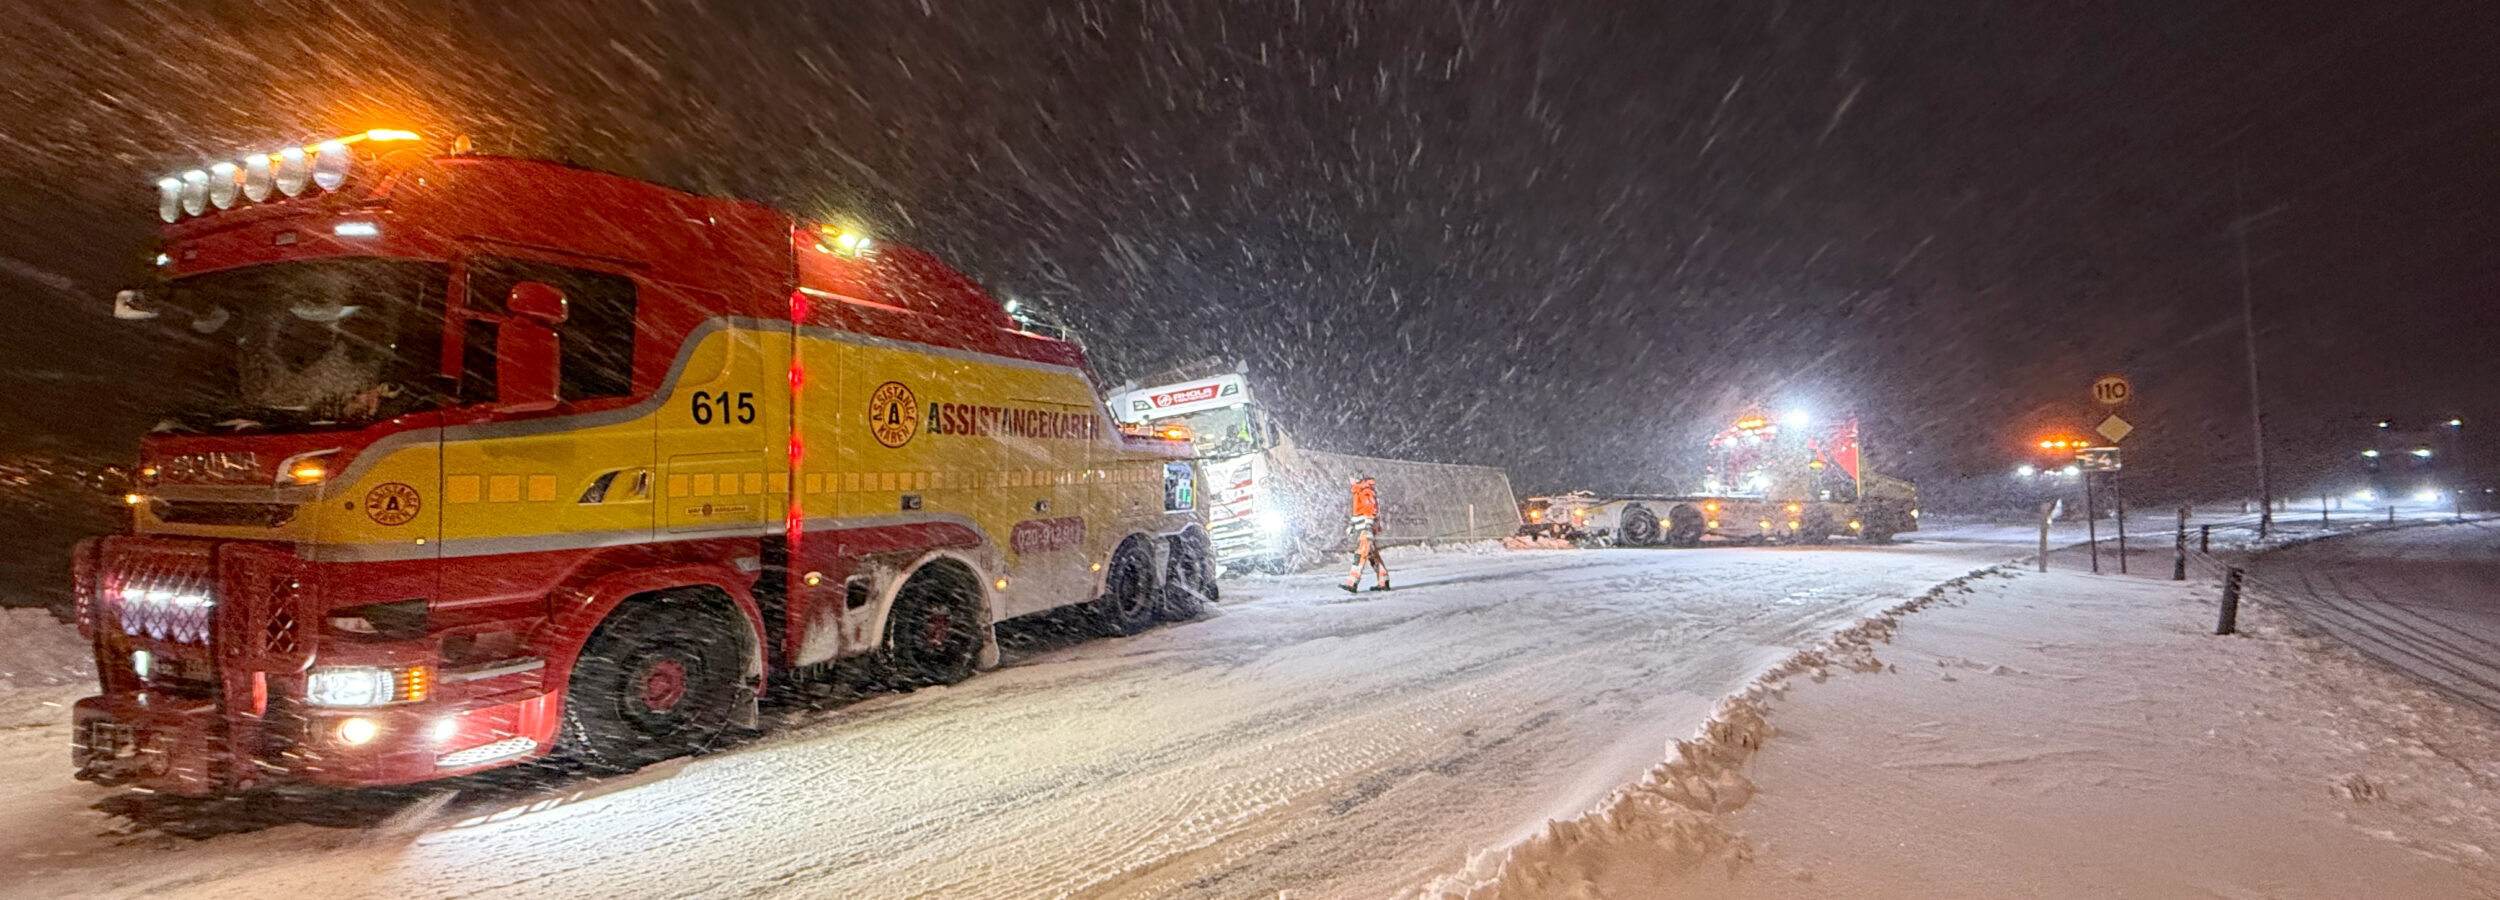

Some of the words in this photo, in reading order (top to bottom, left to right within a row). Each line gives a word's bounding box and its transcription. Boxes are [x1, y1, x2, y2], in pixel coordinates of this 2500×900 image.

[873, 386, 915, 421] ASSISTANCE
[2096, 382, 2126, 399] 110
[692, 391, 755, 425] 615
[888, 402, 900, 425] A
[926, 402, 1100, 440] ASSISTANCEKÅREN
[386, 495, 399, 510] A
